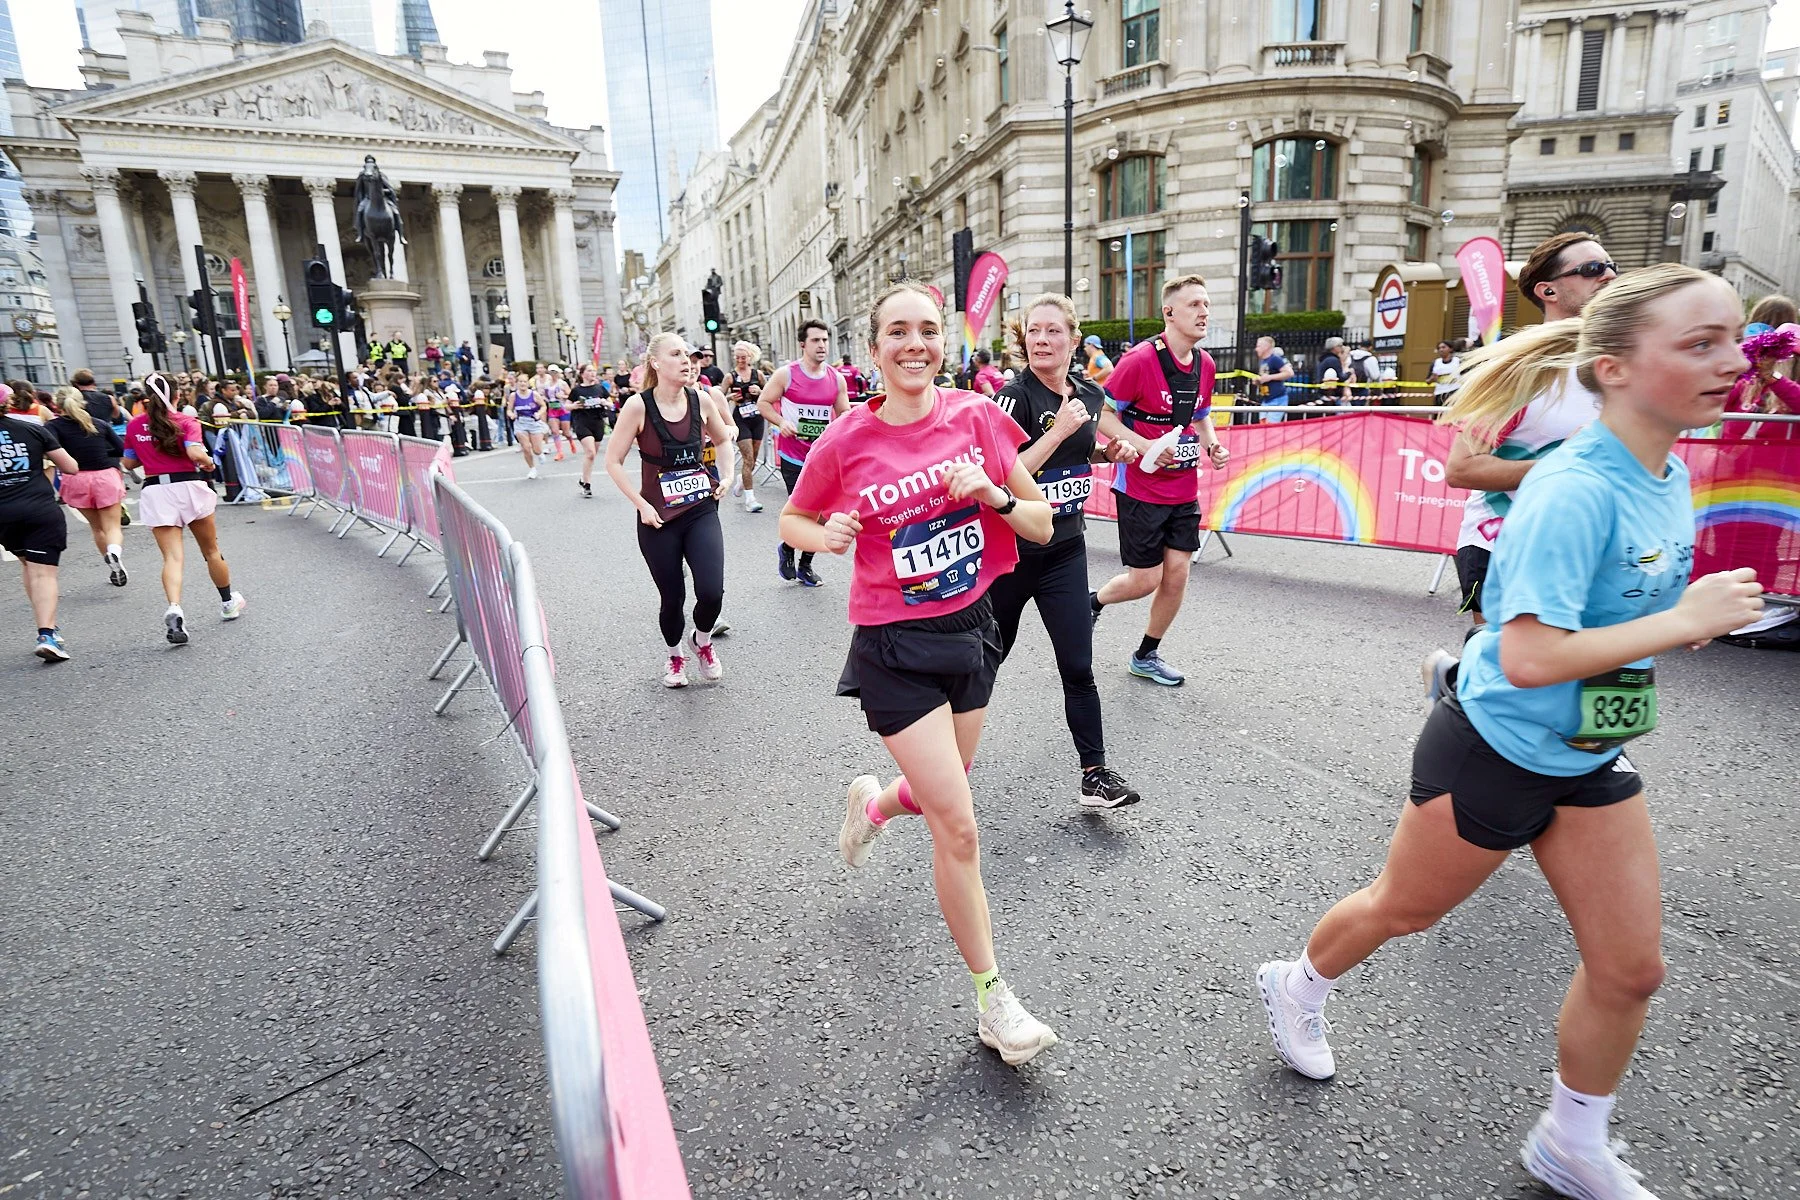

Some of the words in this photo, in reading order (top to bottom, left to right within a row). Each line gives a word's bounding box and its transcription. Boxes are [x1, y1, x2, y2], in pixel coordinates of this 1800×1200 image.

[970, 265, 999, 314] Tommy's
[798, 408, 829, 417] RNIB
[1397, 448, 1446, 483] To
[666, 477, 705, 494] 10597
[1041, 478, 1091, 501] 11936
[1394, 491, 1416, 503] The
[878, 504, 929, 526] Together,
[929, 494, 945, 508] for
[928, 518, 947, 532] IZZY
[902, 525, 980, 573] 11476
[1593, 694, 1650, 729] 8351
